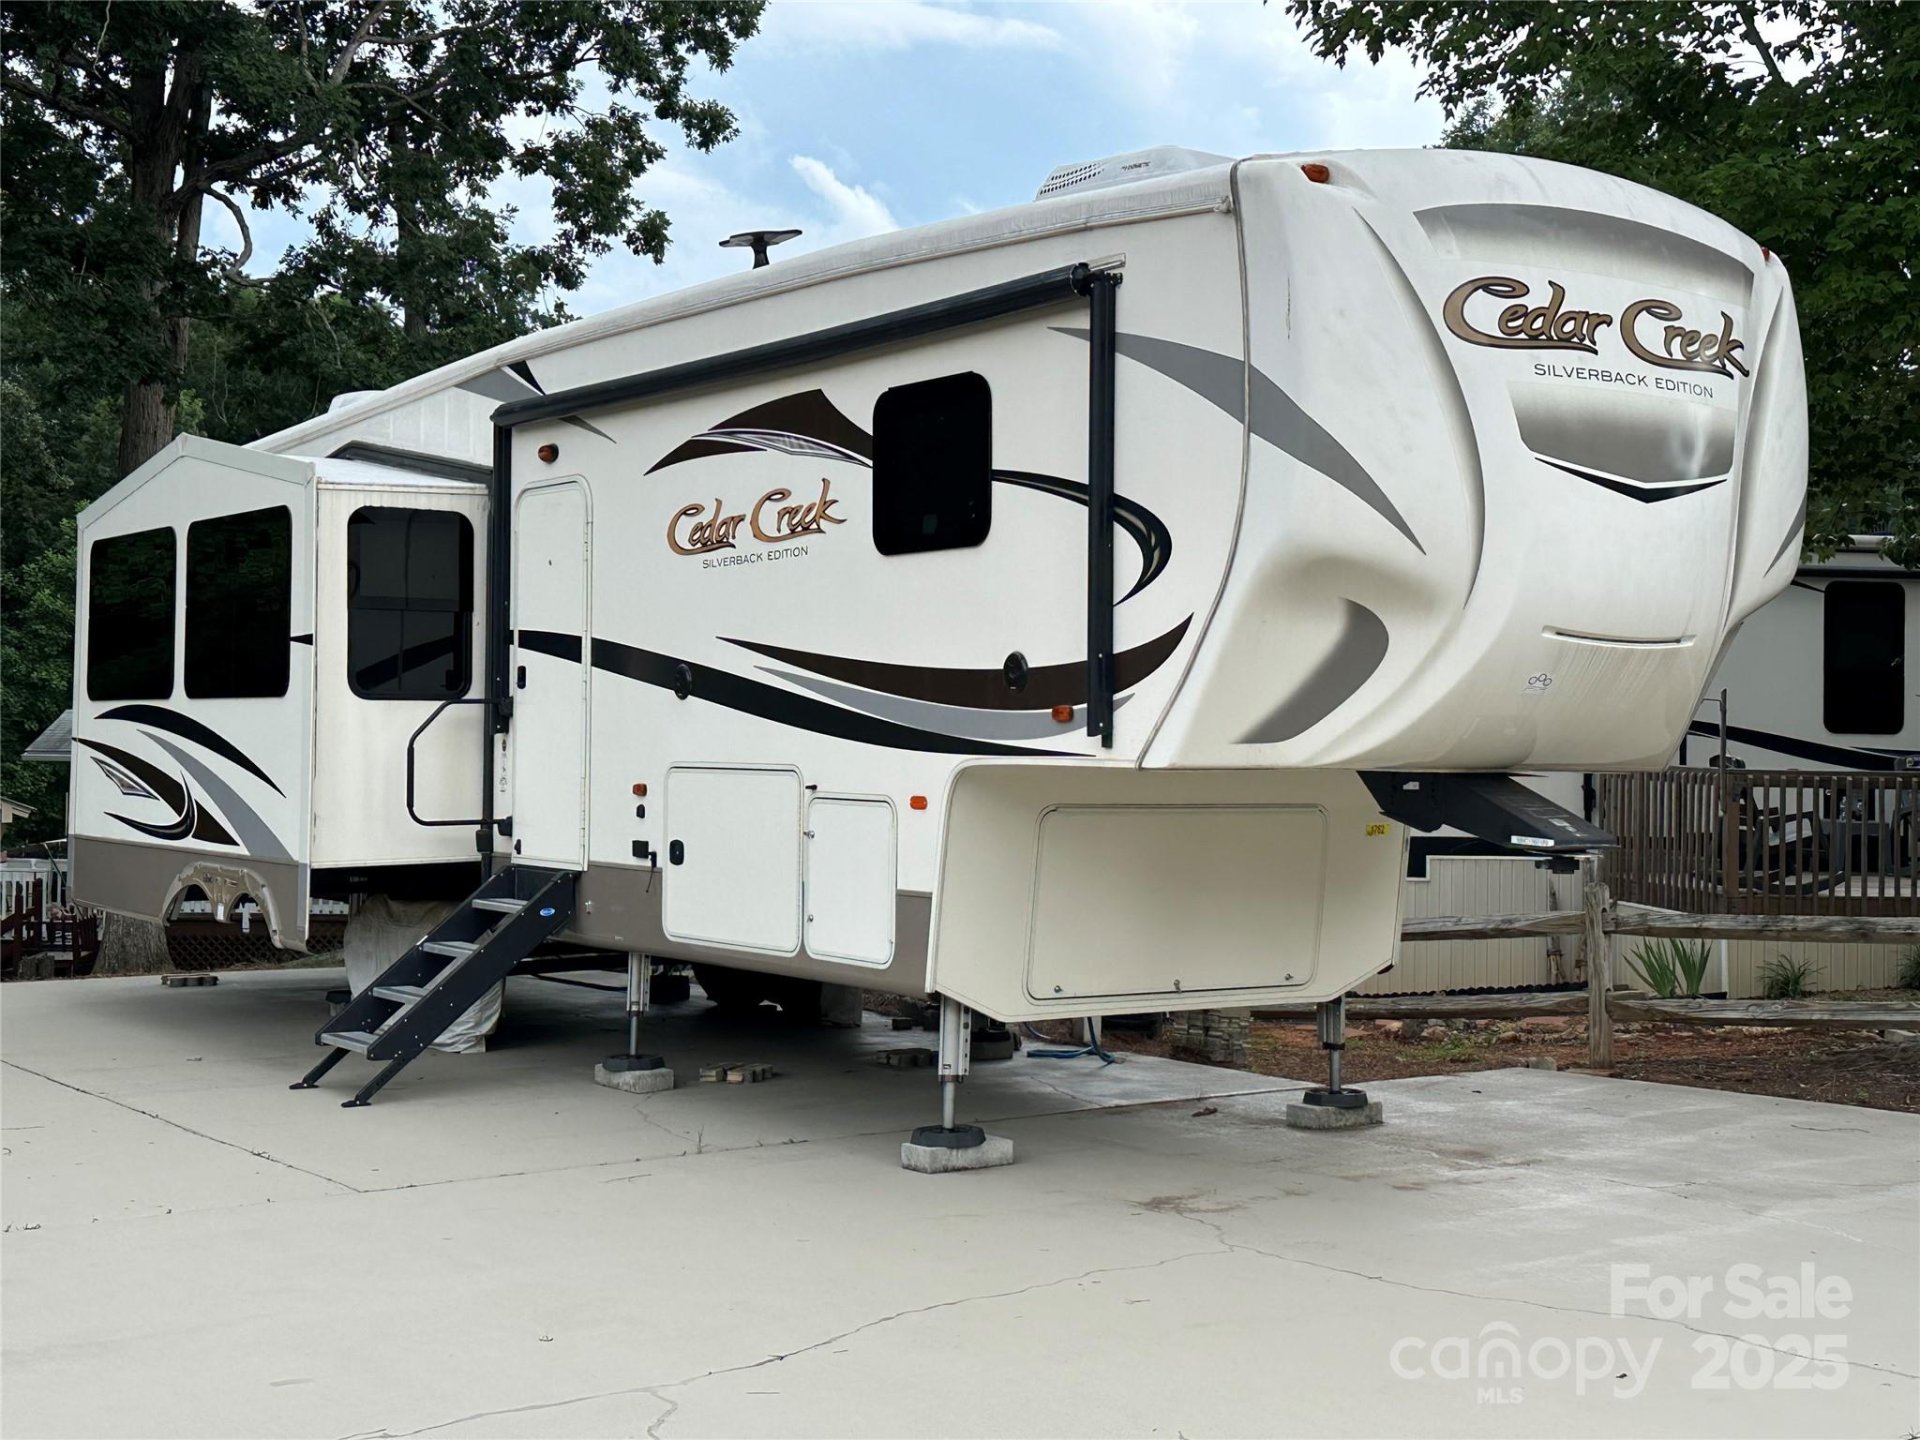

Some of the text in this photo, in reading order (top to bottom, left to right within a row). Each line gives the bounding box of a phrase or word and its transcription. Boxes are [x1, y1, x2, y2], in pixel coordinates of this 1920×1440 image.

[1443, 276, 1749, 379] Cedar Creek
[1534, 363, 1714, 399] SILVERBACK EDITION
[667, 478, 848, 556] Cedar Creek
[702, 546, 809, 569] SILVERBACK EDITION
